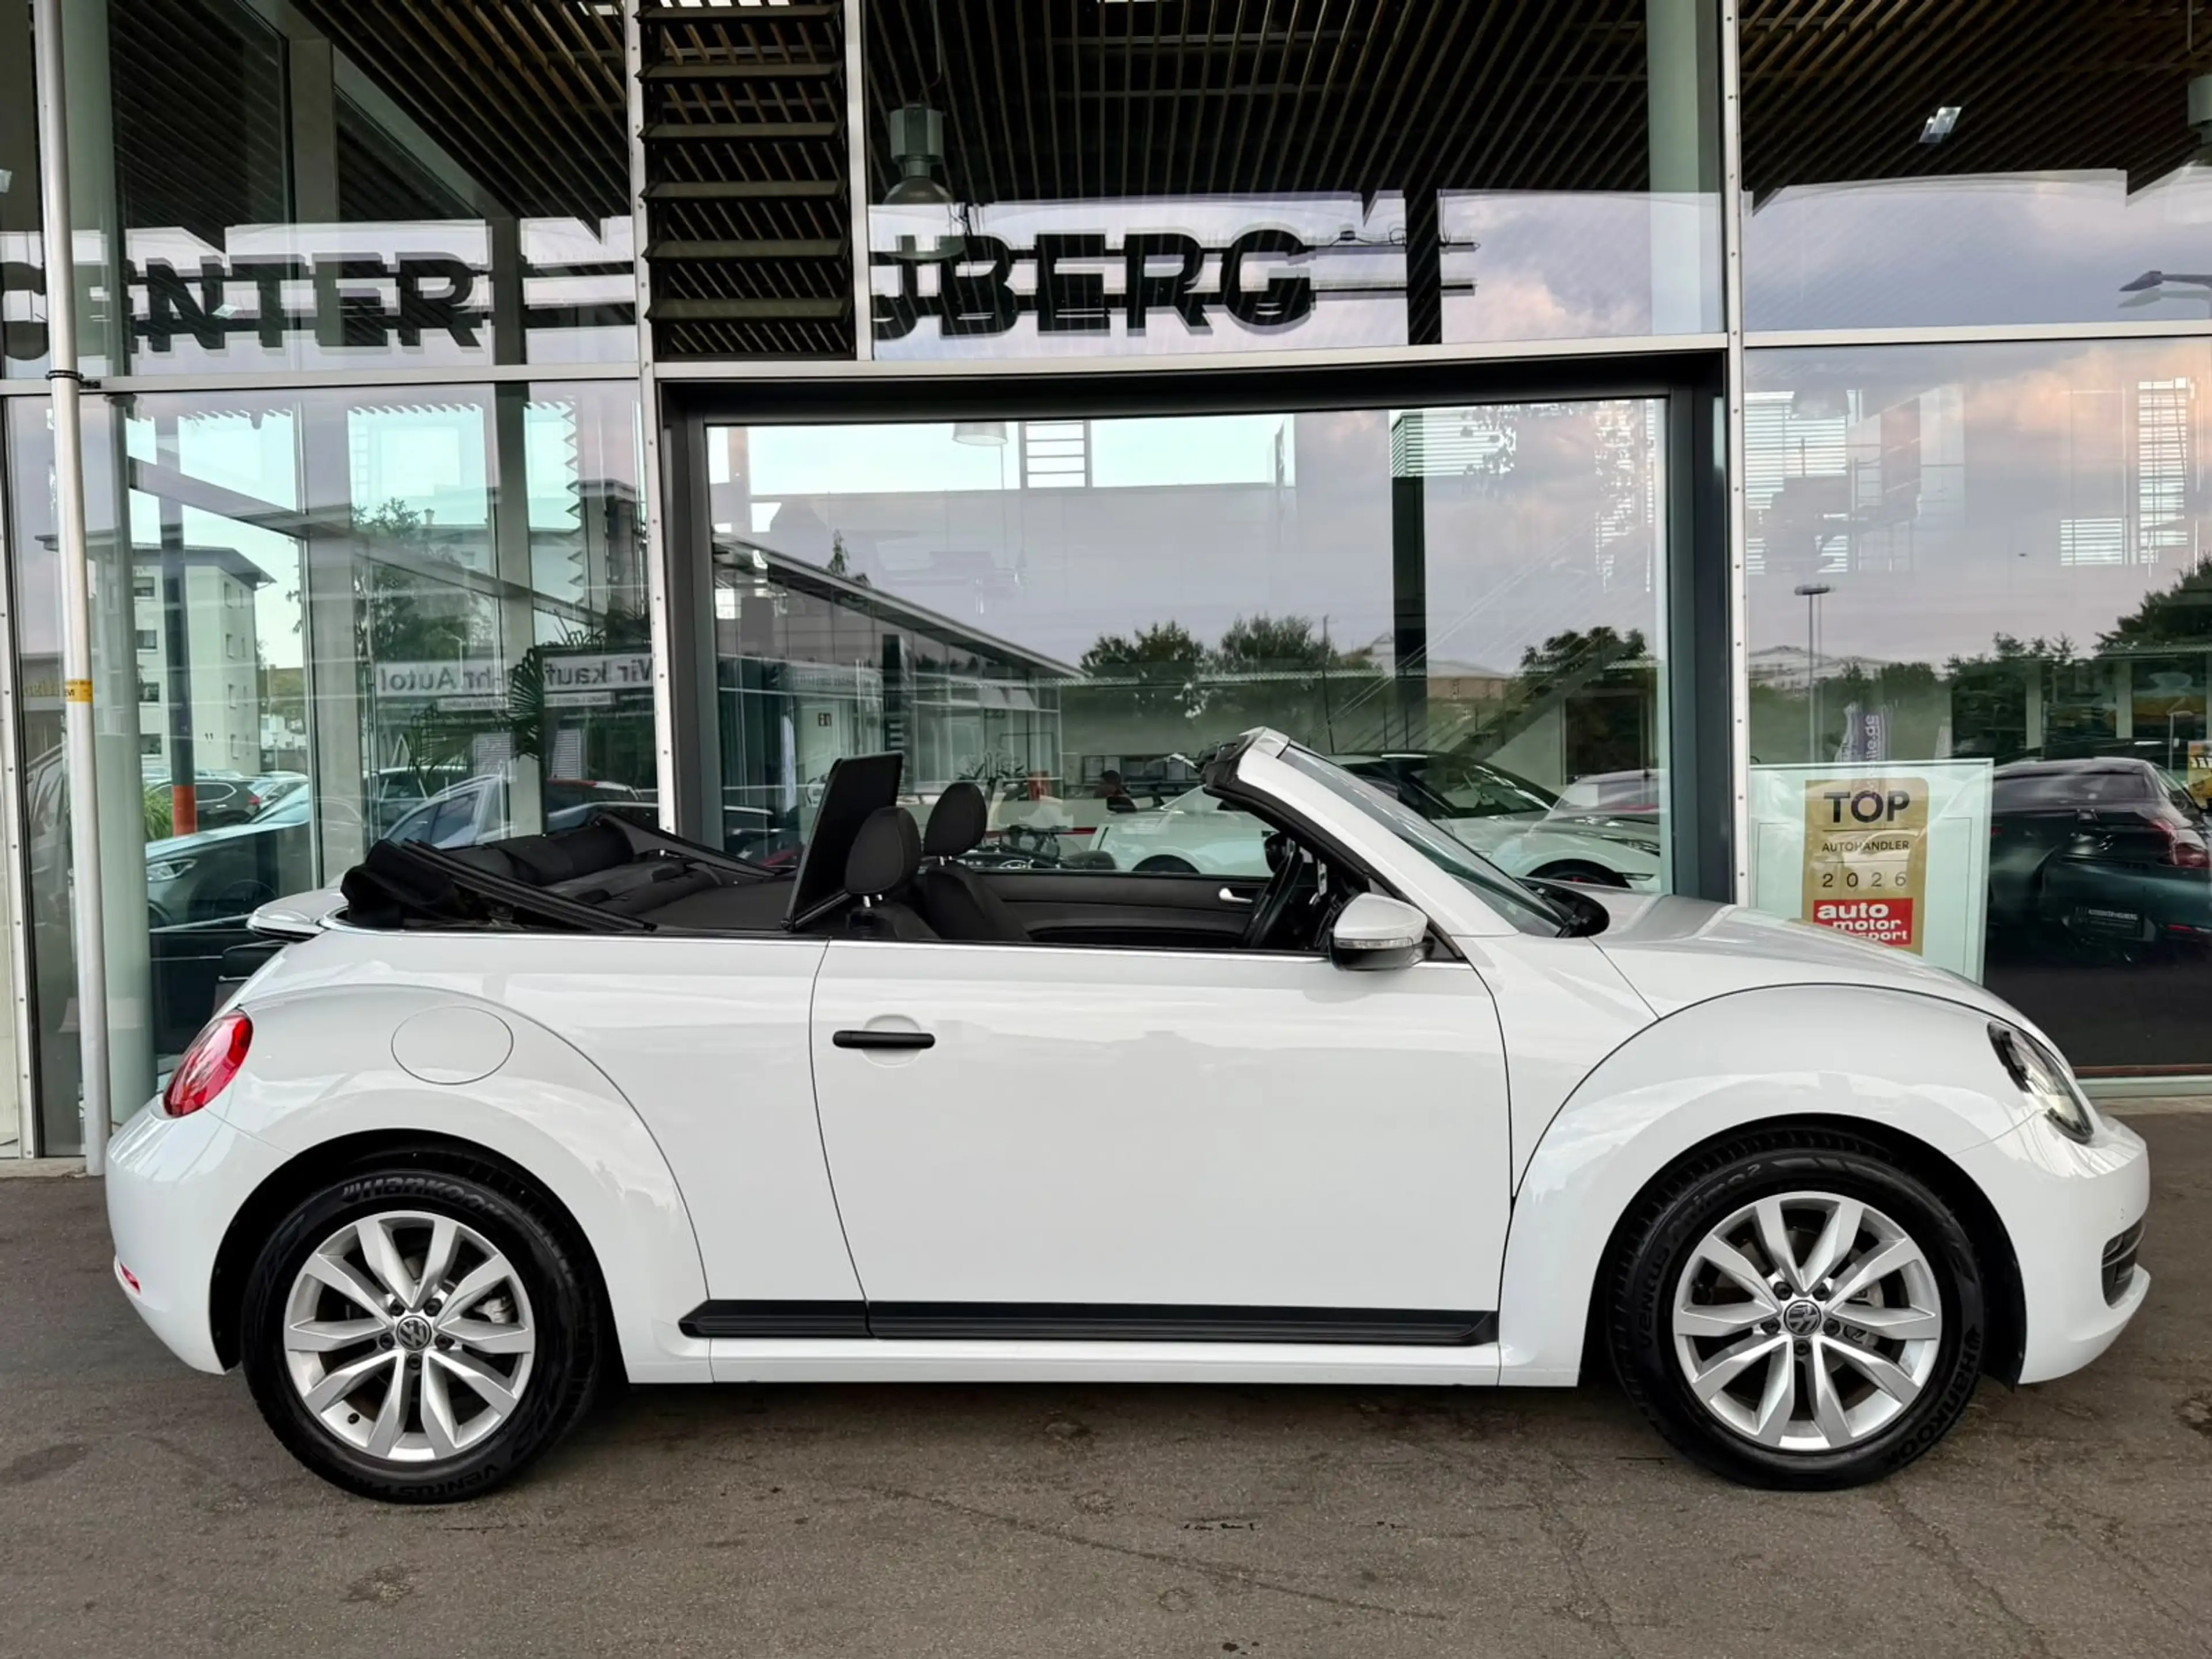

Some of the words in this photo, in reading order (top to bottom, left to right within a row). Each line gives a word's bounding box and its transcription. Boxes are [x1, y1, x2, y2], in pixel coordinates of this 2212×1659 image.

[1823, 790, 1910, 823] TOP
[1817, 902, 1889, 920] auto
[1832, 919, 1902, 931] motor
